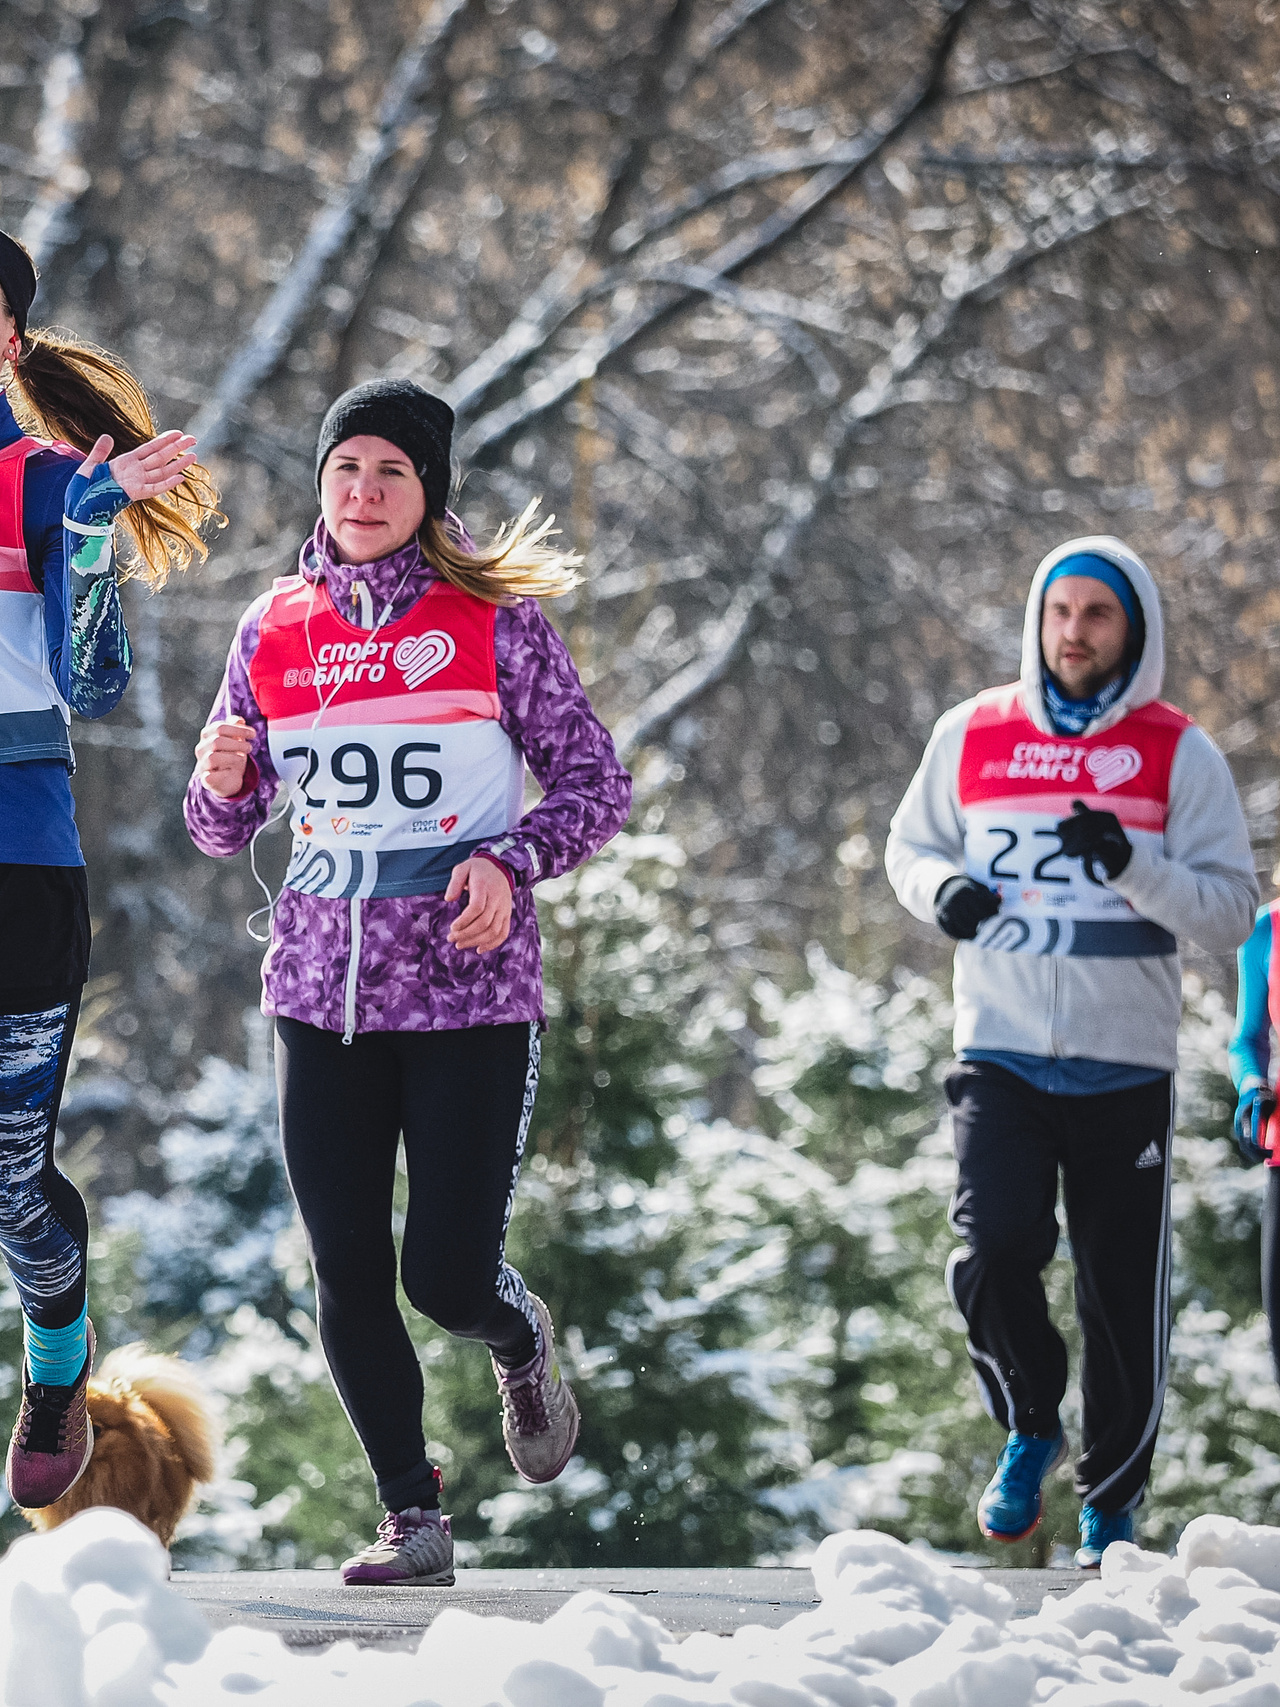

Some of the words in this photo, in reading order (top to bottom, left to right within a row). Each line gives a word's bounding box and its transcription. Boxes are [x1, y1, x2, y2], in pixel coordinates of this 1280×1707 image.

[318, 642, 394, 664] СПОРТ
[1013, 742, 1086, 765] СПОРТ
[283, 743, 442, 809] 296
